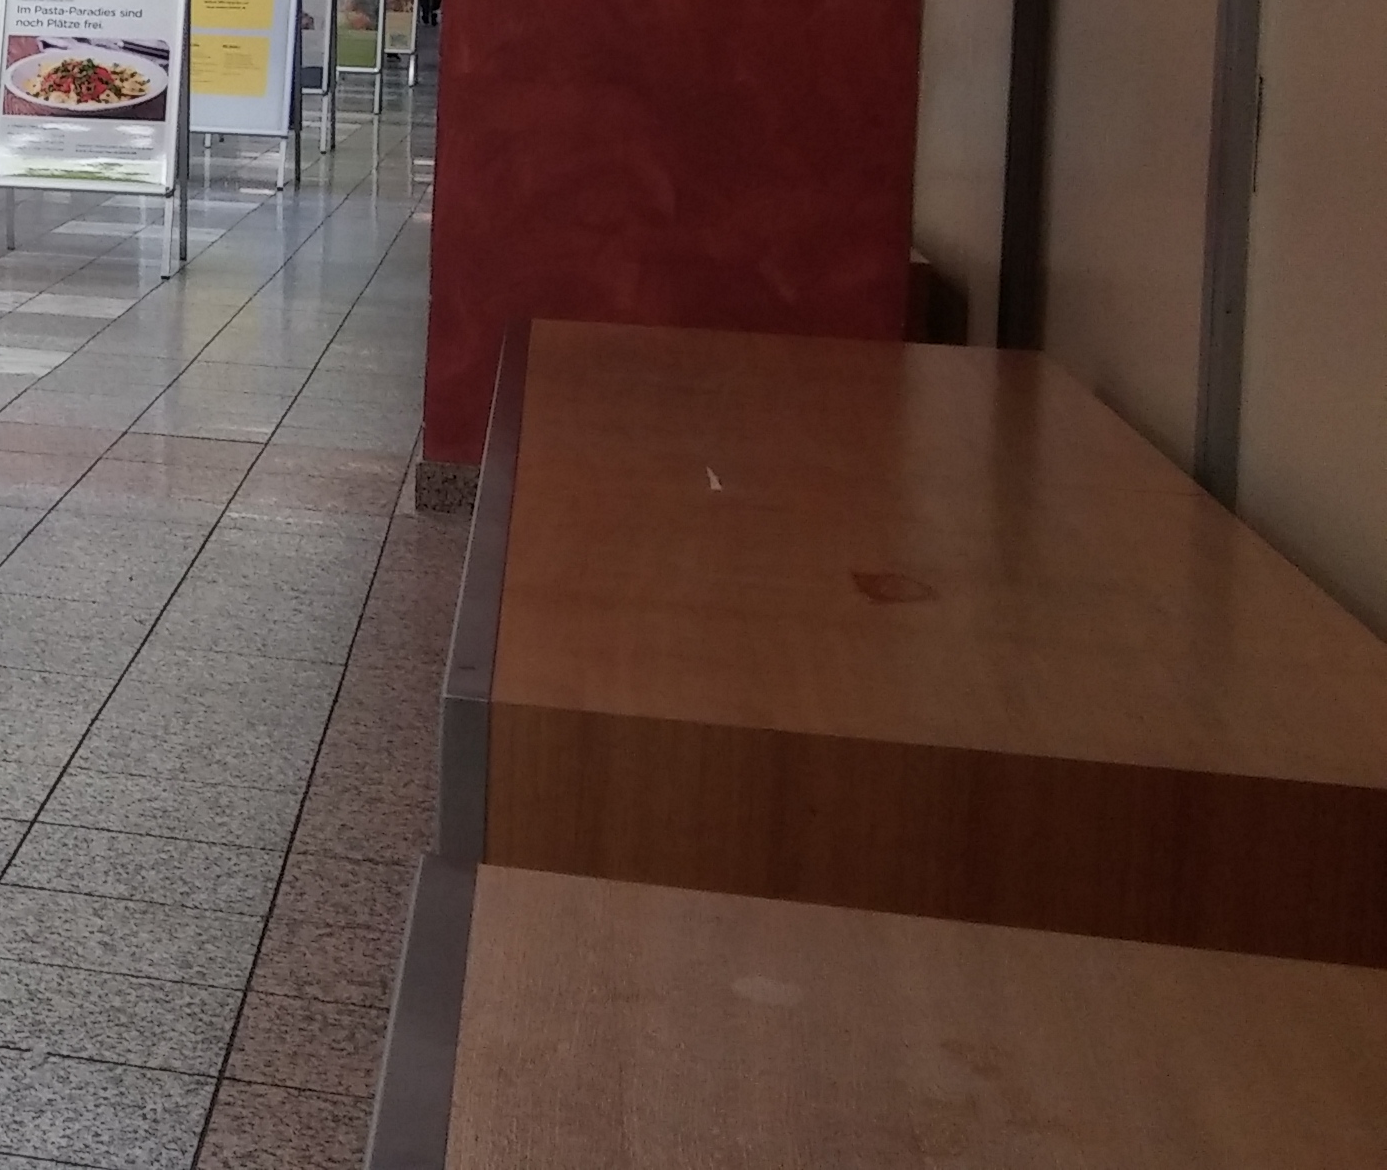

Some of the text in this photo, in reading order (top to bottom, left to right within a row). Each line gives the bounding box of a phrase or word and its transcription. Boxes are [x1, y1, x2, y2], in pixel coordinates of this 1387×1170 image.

[17, 5, 143, 18] Im Pasta-Paradies sind
[15, 18, 103, 29] noch Plätze frei.
